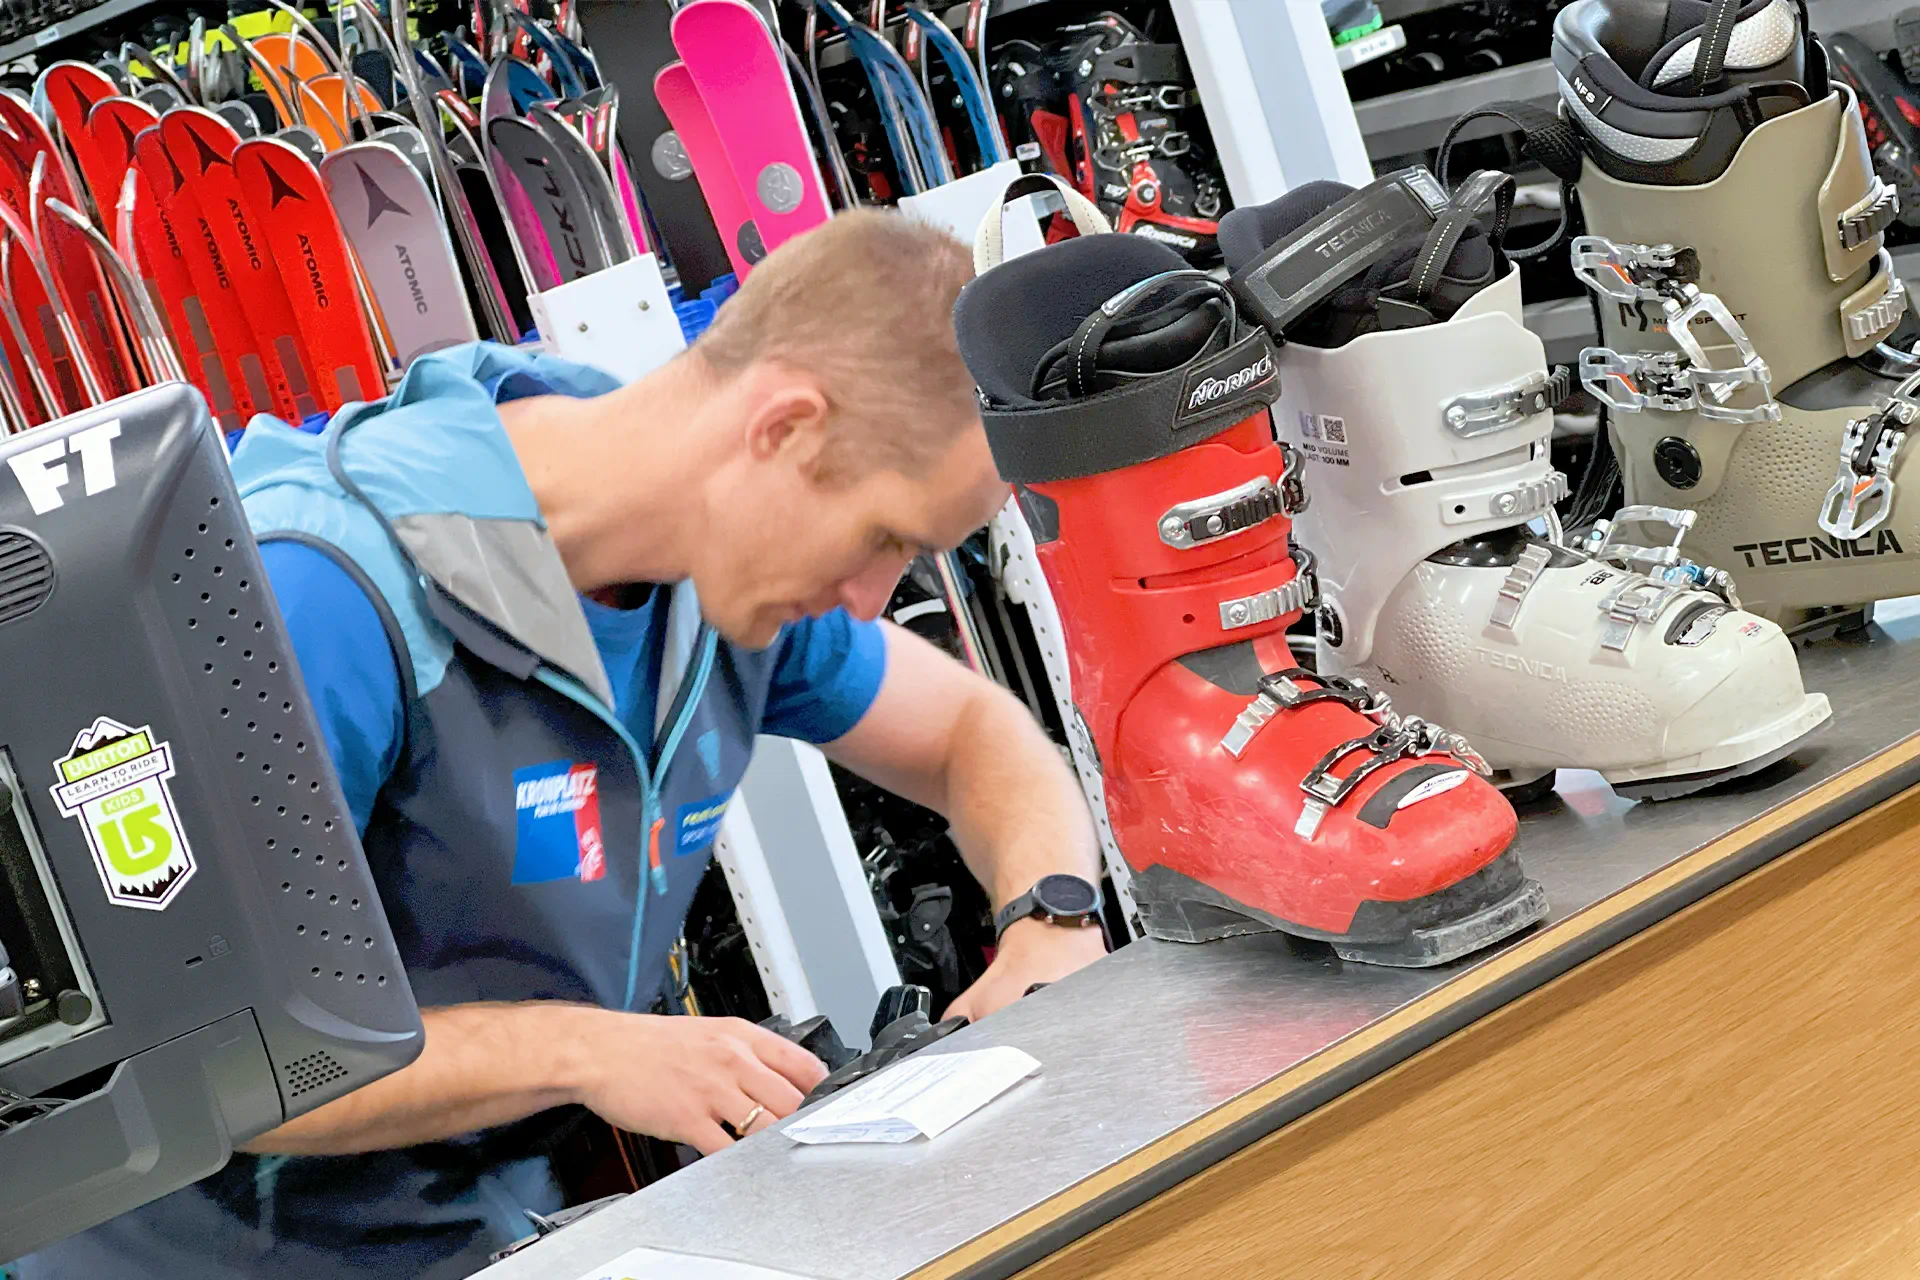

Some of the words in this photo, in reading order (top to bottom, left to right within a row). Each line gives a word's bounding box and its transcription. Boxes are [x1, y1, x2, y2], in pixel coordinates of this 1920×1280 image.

[1574, 76, 1596, 104] NFS
[198, 217, 230, 289] ATOMIC
[227, 198, 262, 271] ATOMIC
[1314, 209, 1392, 258] TECNICA
[297, 233, 329, 309] ATOMIC
[394, 244, 429, 315] ATOMIC
[6, 418, 122, 516] FT
[1302, 442, 1316, 452] MID
[1318, 446, 1349, 458] VOLUME
[1322, 456, 1335, 465] 100
[1336, 457, 1350, 466] MM
[1732, 529, 1904, 568] TECNICA
[1475, 646, 1567, 684] TECNICA
[65, 737, 147, 778] BURTON
[66, 775, 109, 797] LEARN
[112, 768, 127, 779] TO
[130, 755, 159, 772] RIDE
[98, 775, 133, 791] CENTER
[105, 791, 140, 813] KIDS
